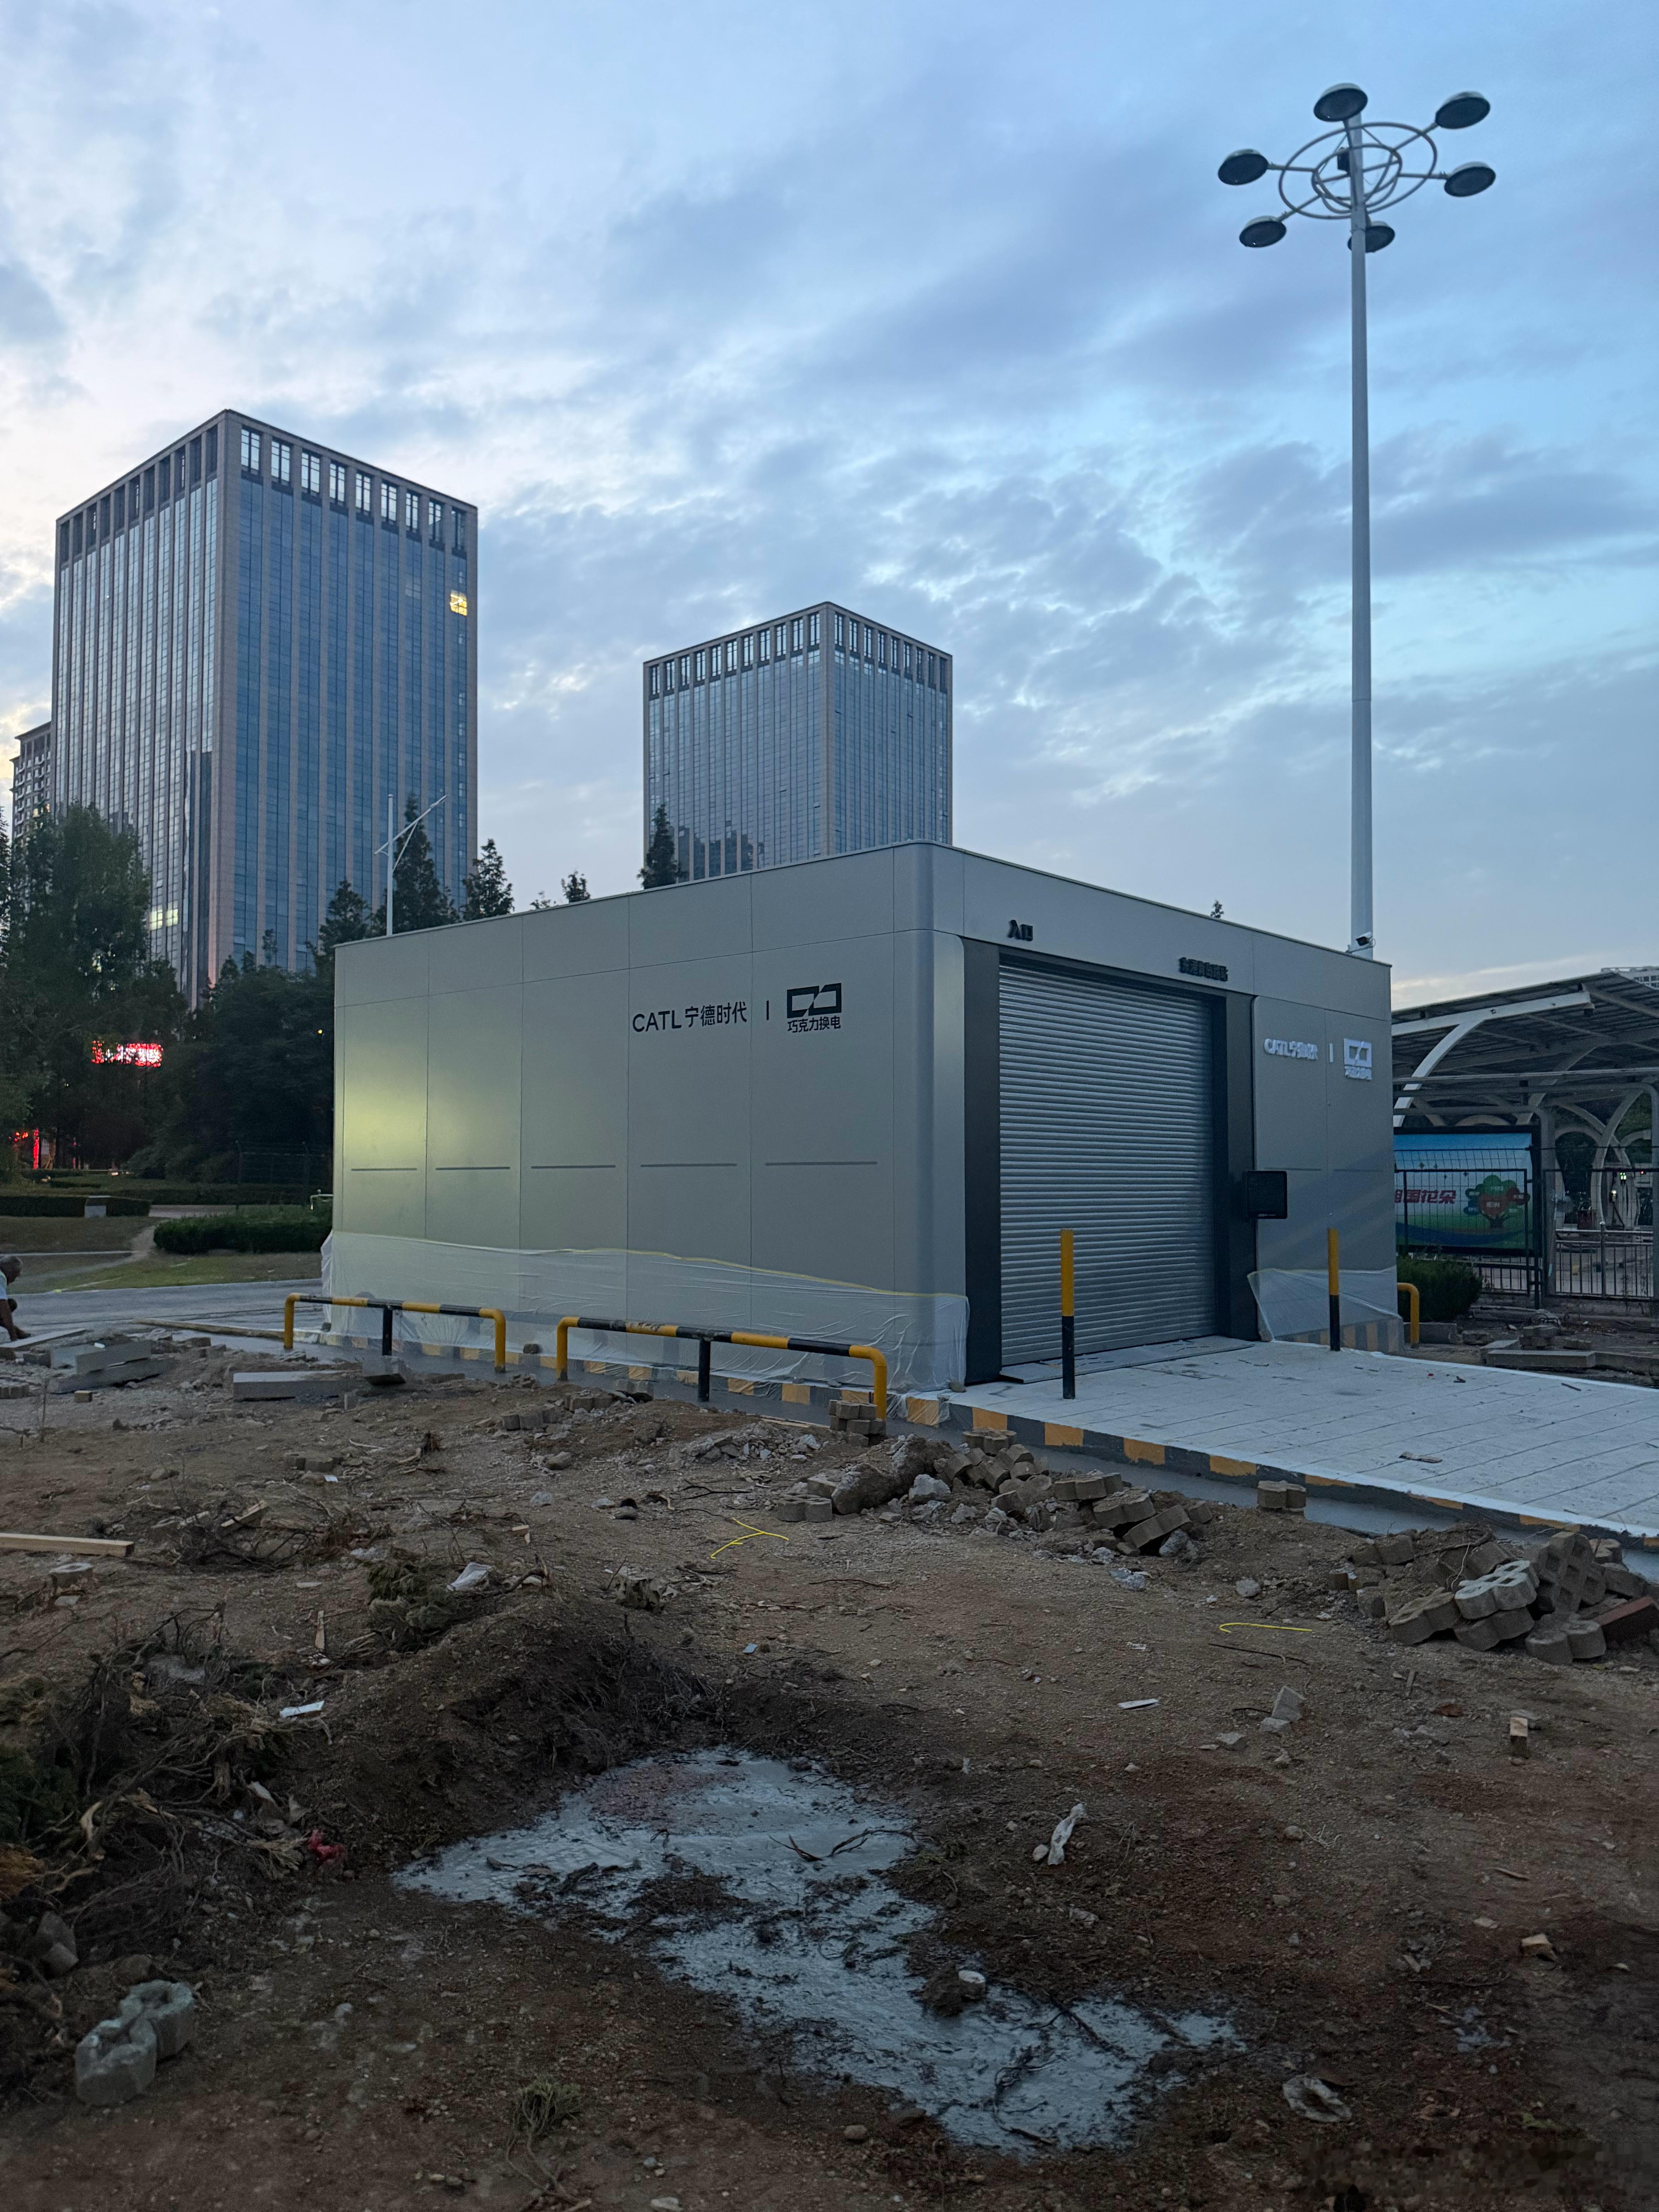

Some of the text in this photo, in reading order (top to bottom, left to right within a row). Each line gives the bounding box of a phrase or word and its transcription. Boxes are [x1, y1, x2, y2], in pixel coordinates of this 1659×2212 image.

[633, 1001, 747, 1032] CATL 宁德时代
[788, 1015, 841, 1033] 巧克力换电
